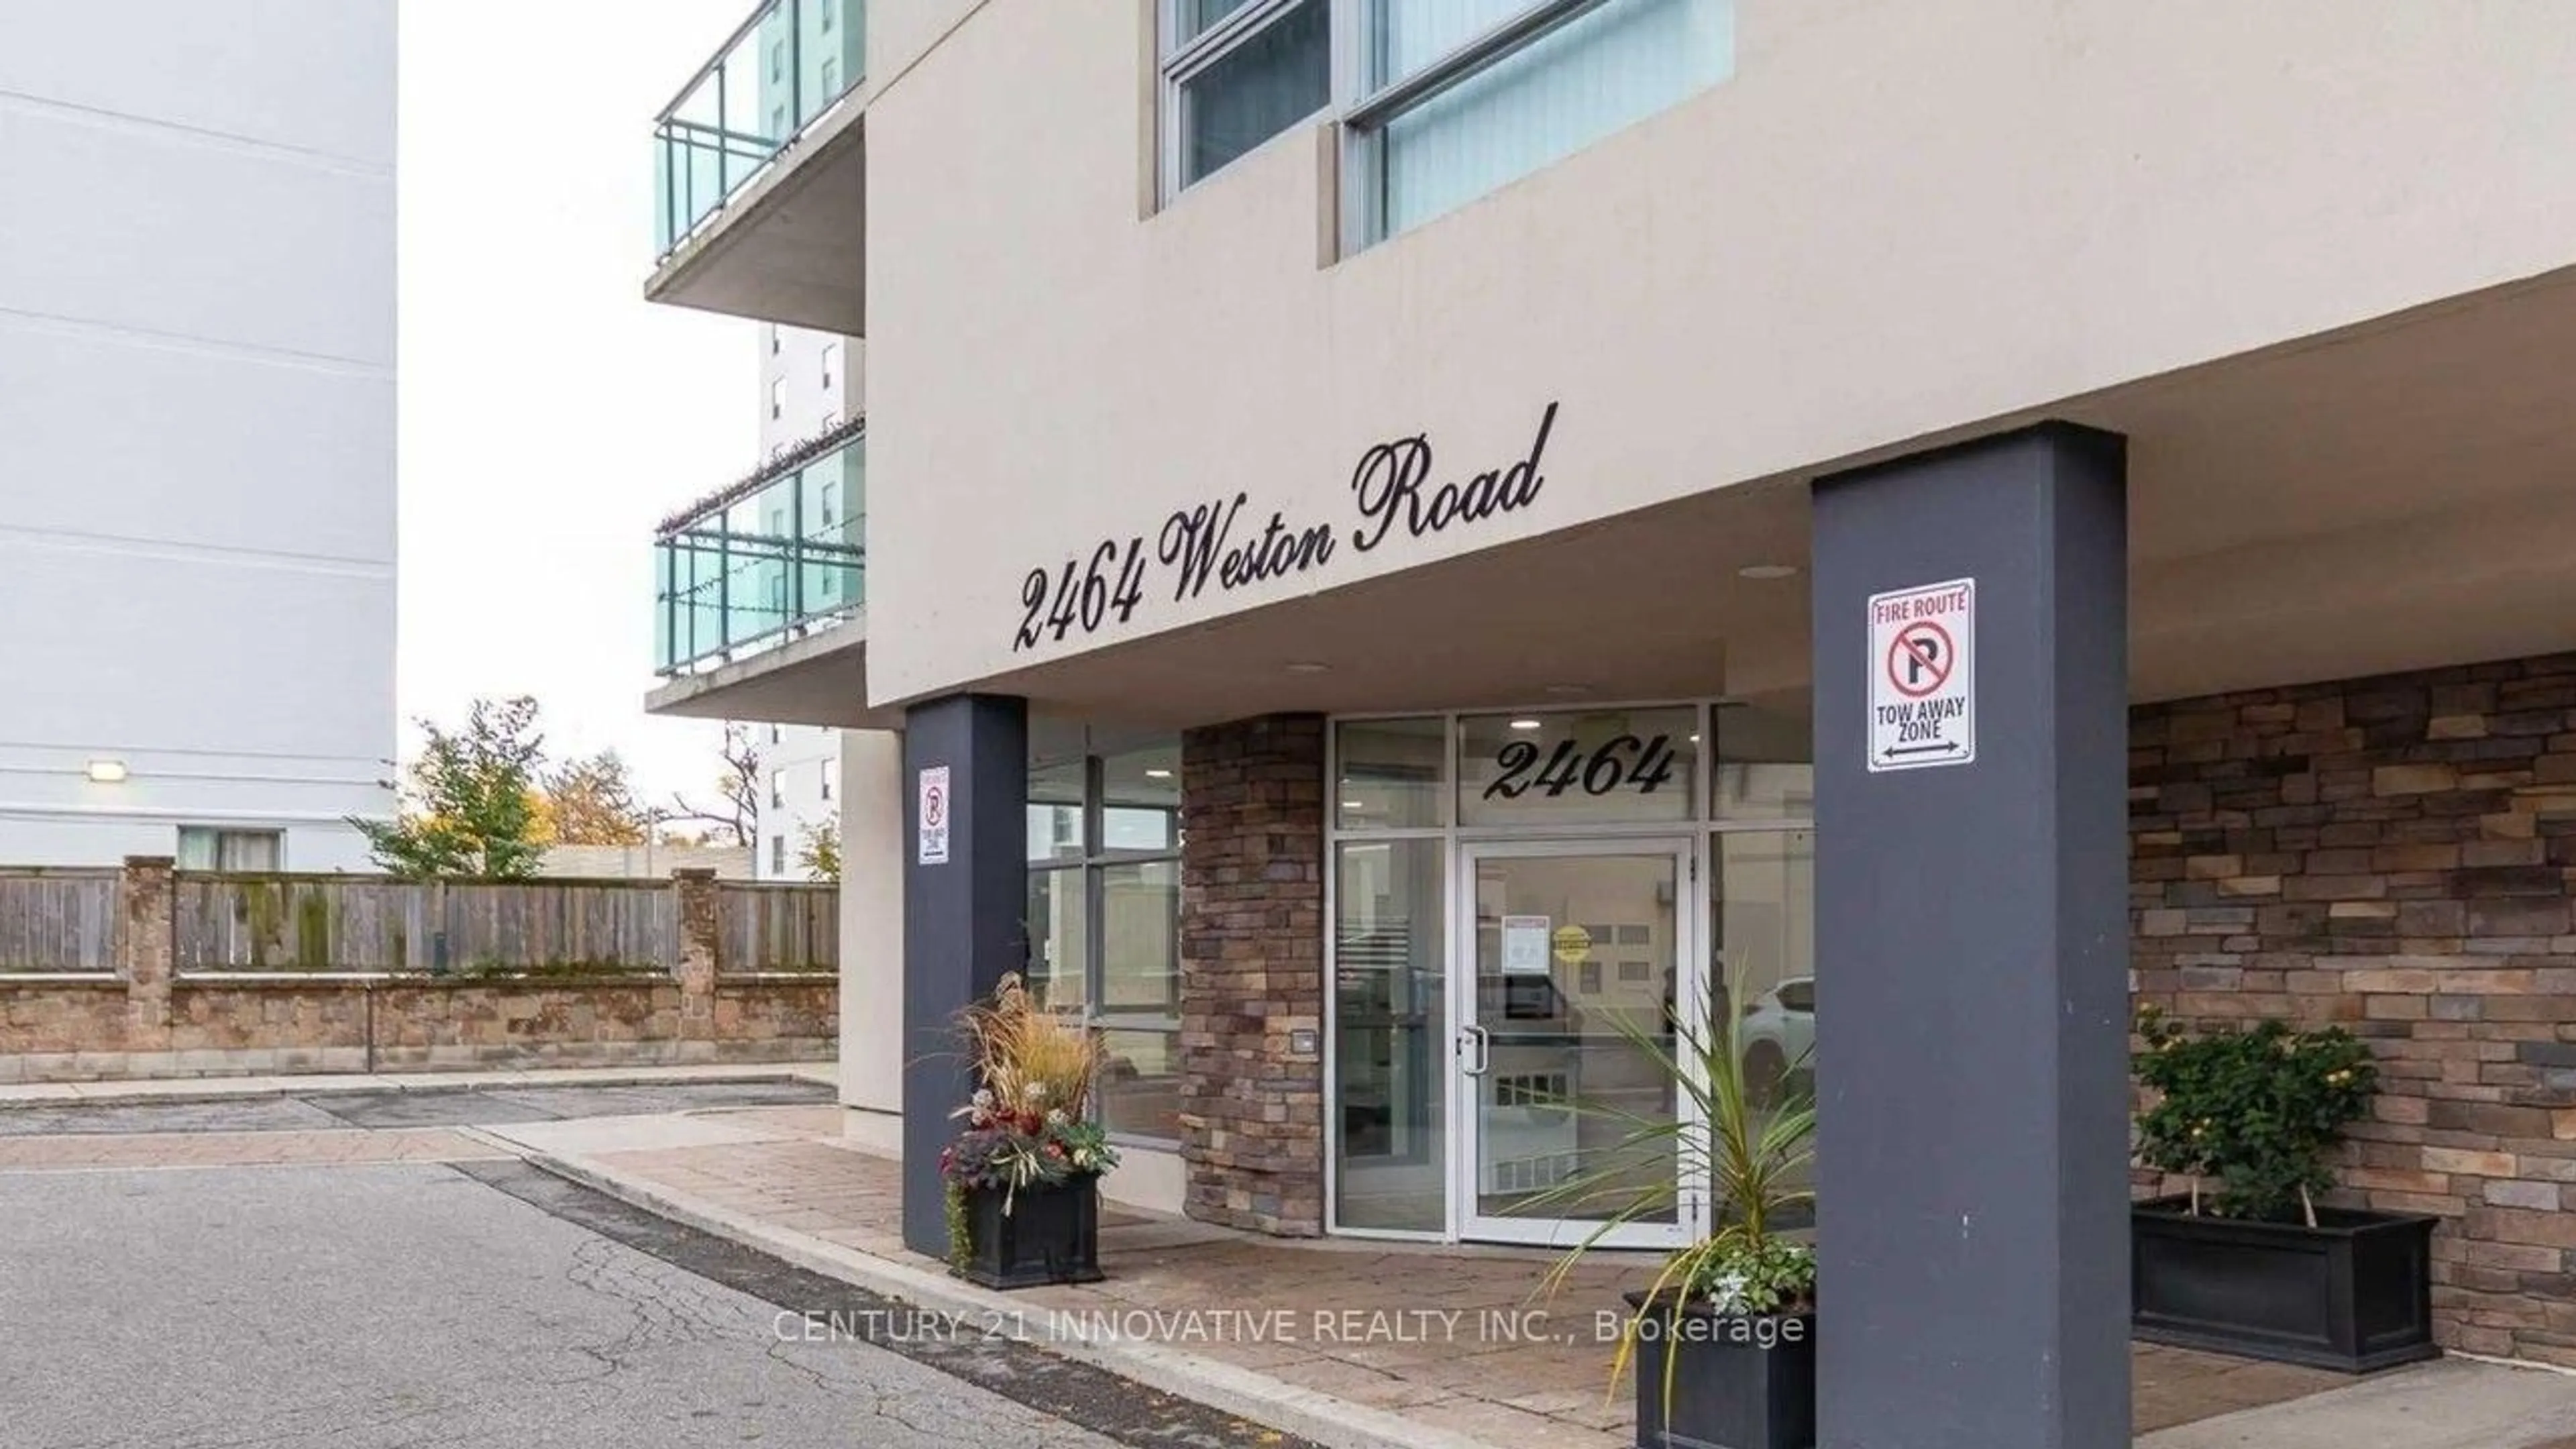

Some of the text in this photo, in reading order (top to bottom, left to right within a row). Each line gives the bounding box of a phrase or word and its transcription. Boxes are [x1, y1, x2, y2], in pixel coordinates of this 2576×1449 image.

[1014, 401, 1558, 652] 2464 Weston Road
[1878, 592, 1966, 624] FIRE ROUTE
[1877, 696, 1966, 725] TOW AWAY
[1899, 720, 1941, 742] ZONE
[1483, 735, 1675, 800] 2464
